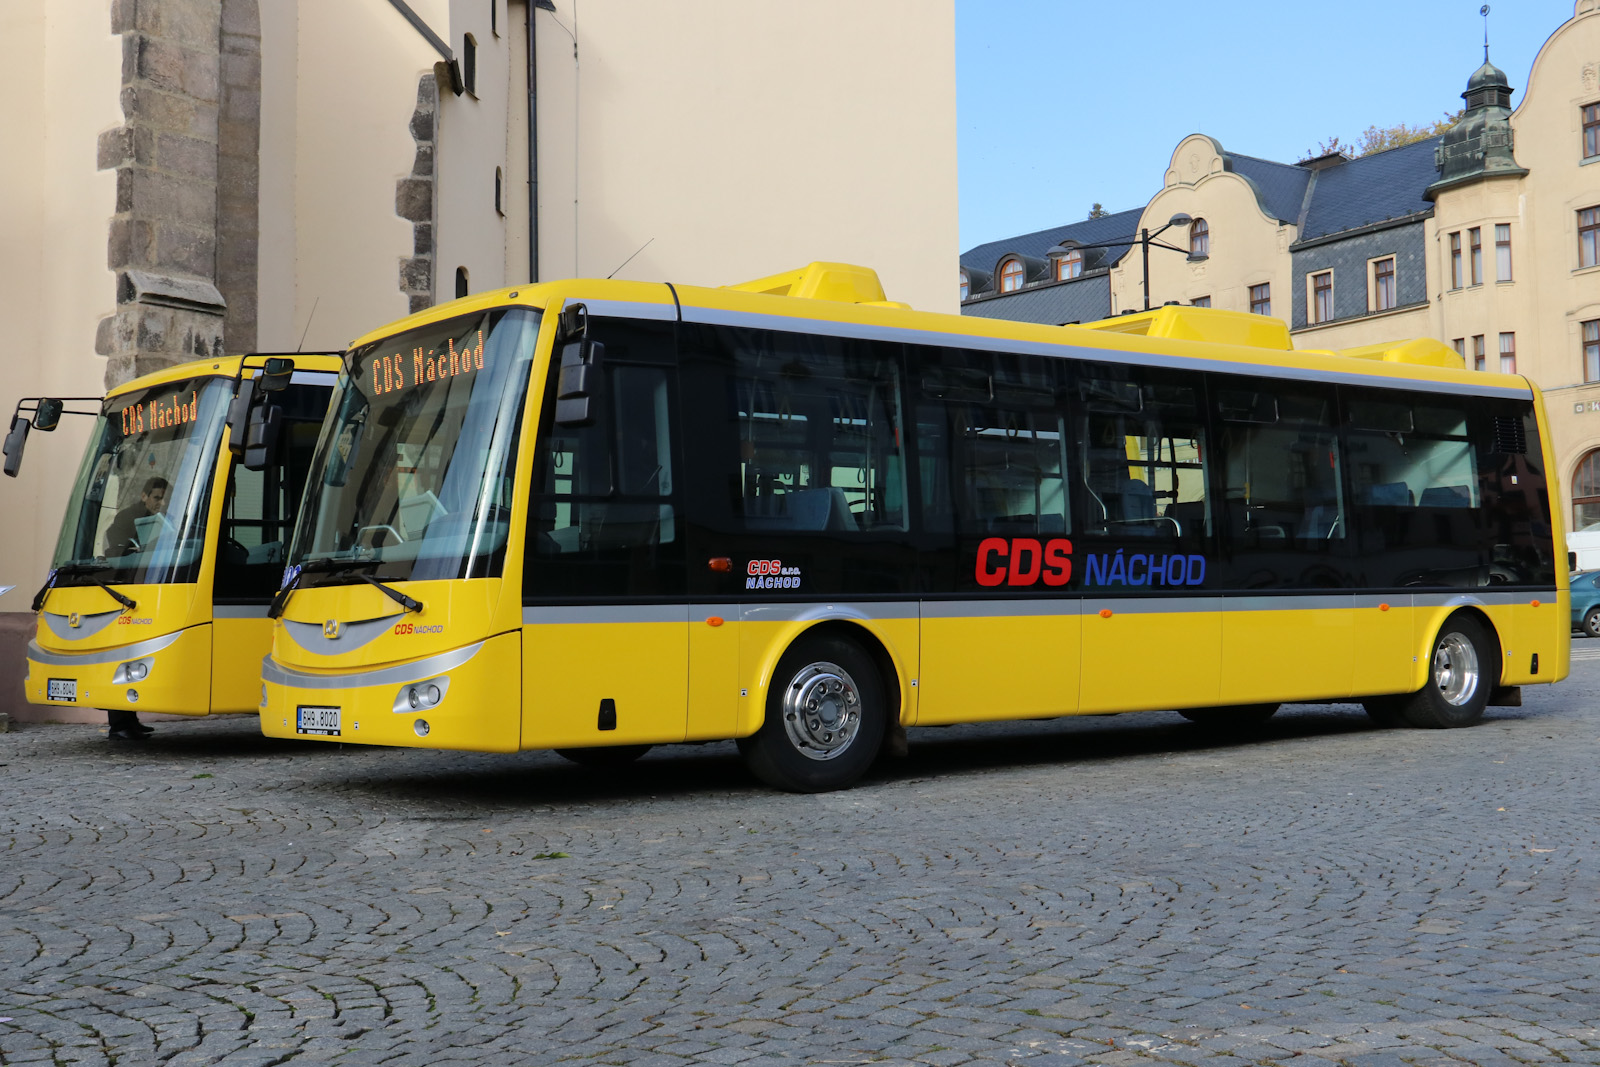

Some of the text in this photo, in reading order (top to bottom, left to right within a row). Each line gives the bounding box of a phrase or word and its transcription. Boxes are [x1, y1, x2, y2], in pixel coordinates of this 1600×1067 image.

[373, 330, 484, 395] CDS Náchod
[122, 390, 197, 435] CDS Náchod
[747, 560, 801, 575] CDS s.r.o.
[975, 537, 1206, 587] CDS NÁCHOD
[746, 576, 800, 589] NÁCHOD
[118, 616, 131, 625] CDS
[394, 623, 413, 635] CDS
[302, 710, 338, 727] 6H9 8020
